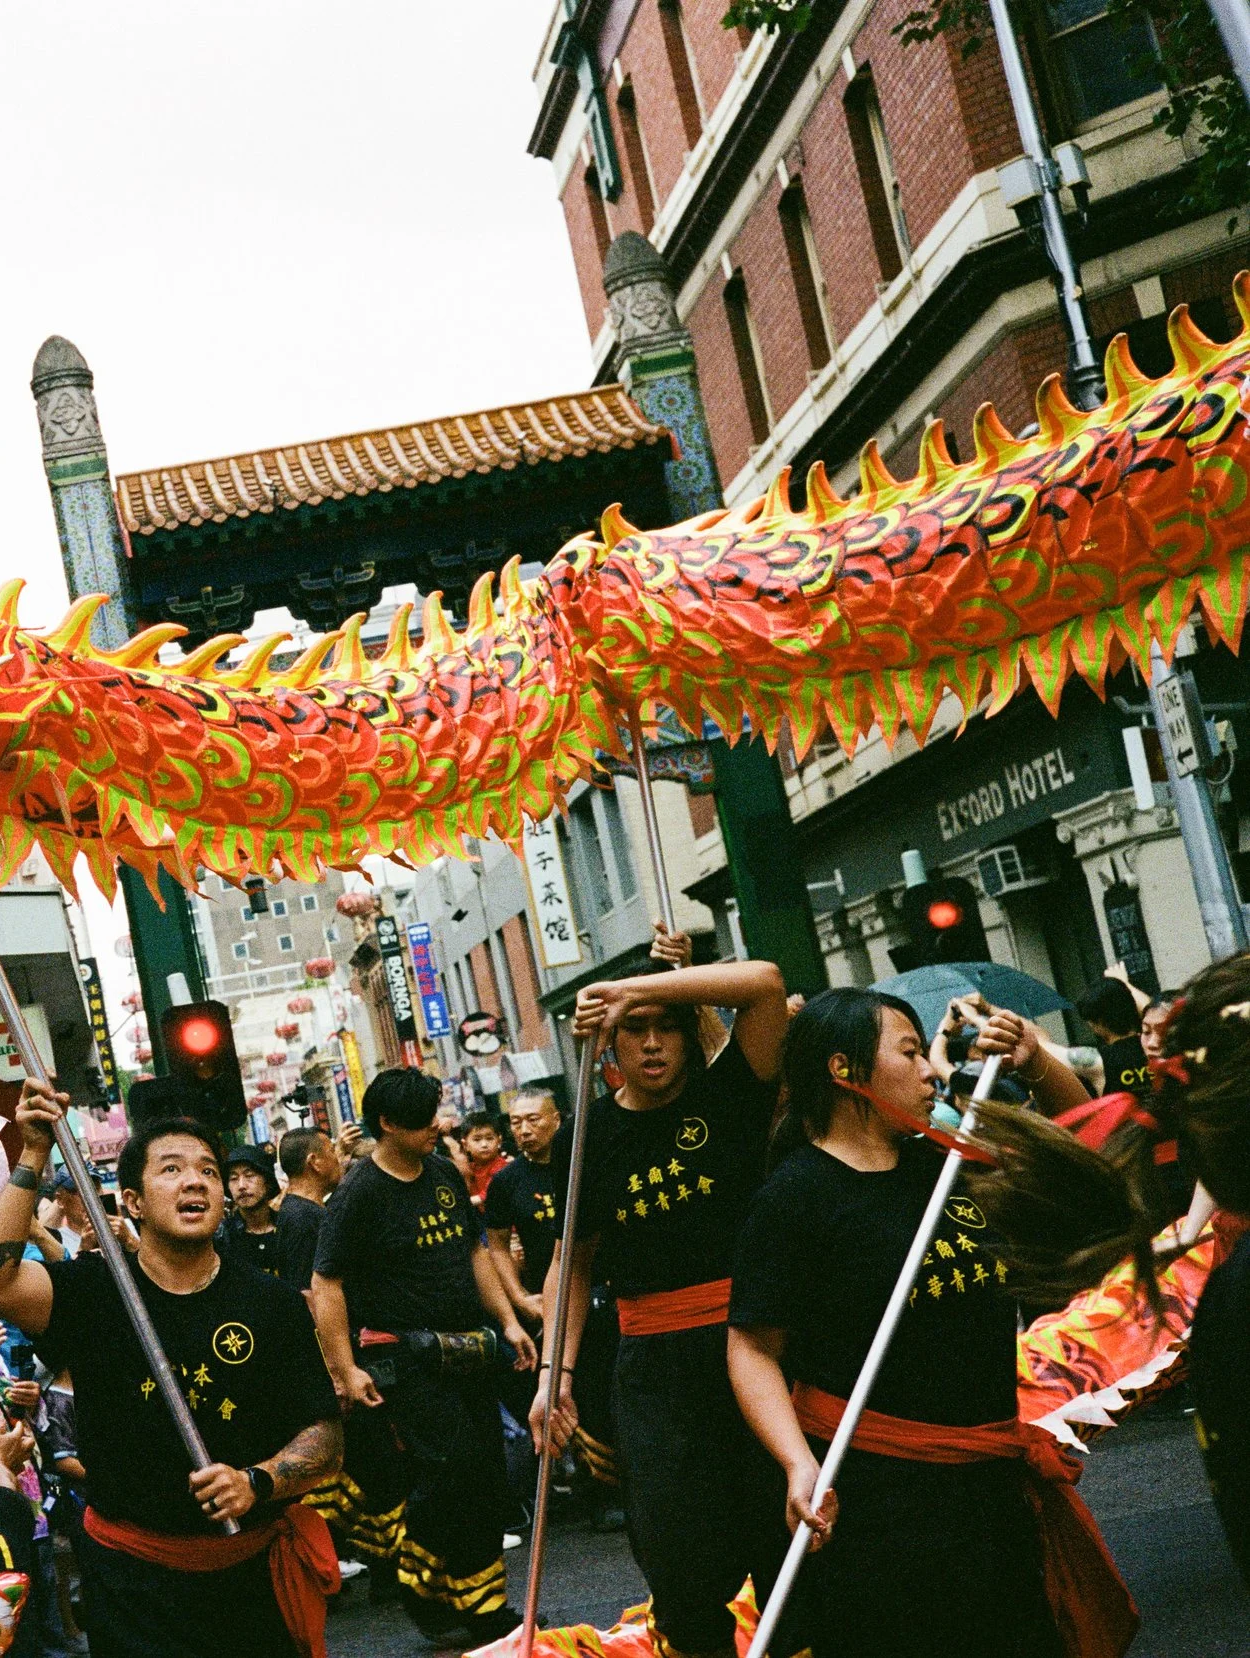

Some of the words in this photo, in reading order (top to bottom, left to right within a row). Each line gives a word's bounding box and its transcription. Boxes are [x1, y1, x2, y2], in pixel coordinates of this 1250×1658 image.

[1162, 685, 1181, 713] ONE
[1168, 713, 1188, 741] WAY
[937, 780, 1005, 841] EXFORD
[1004, 747, 1075, 809] HOTEL
[387, 955, 412, 1022] BORNGA
[627, 1158, 685, 1193] 墨爾本
[616, 1175, 714, 1225] 中華青年會
